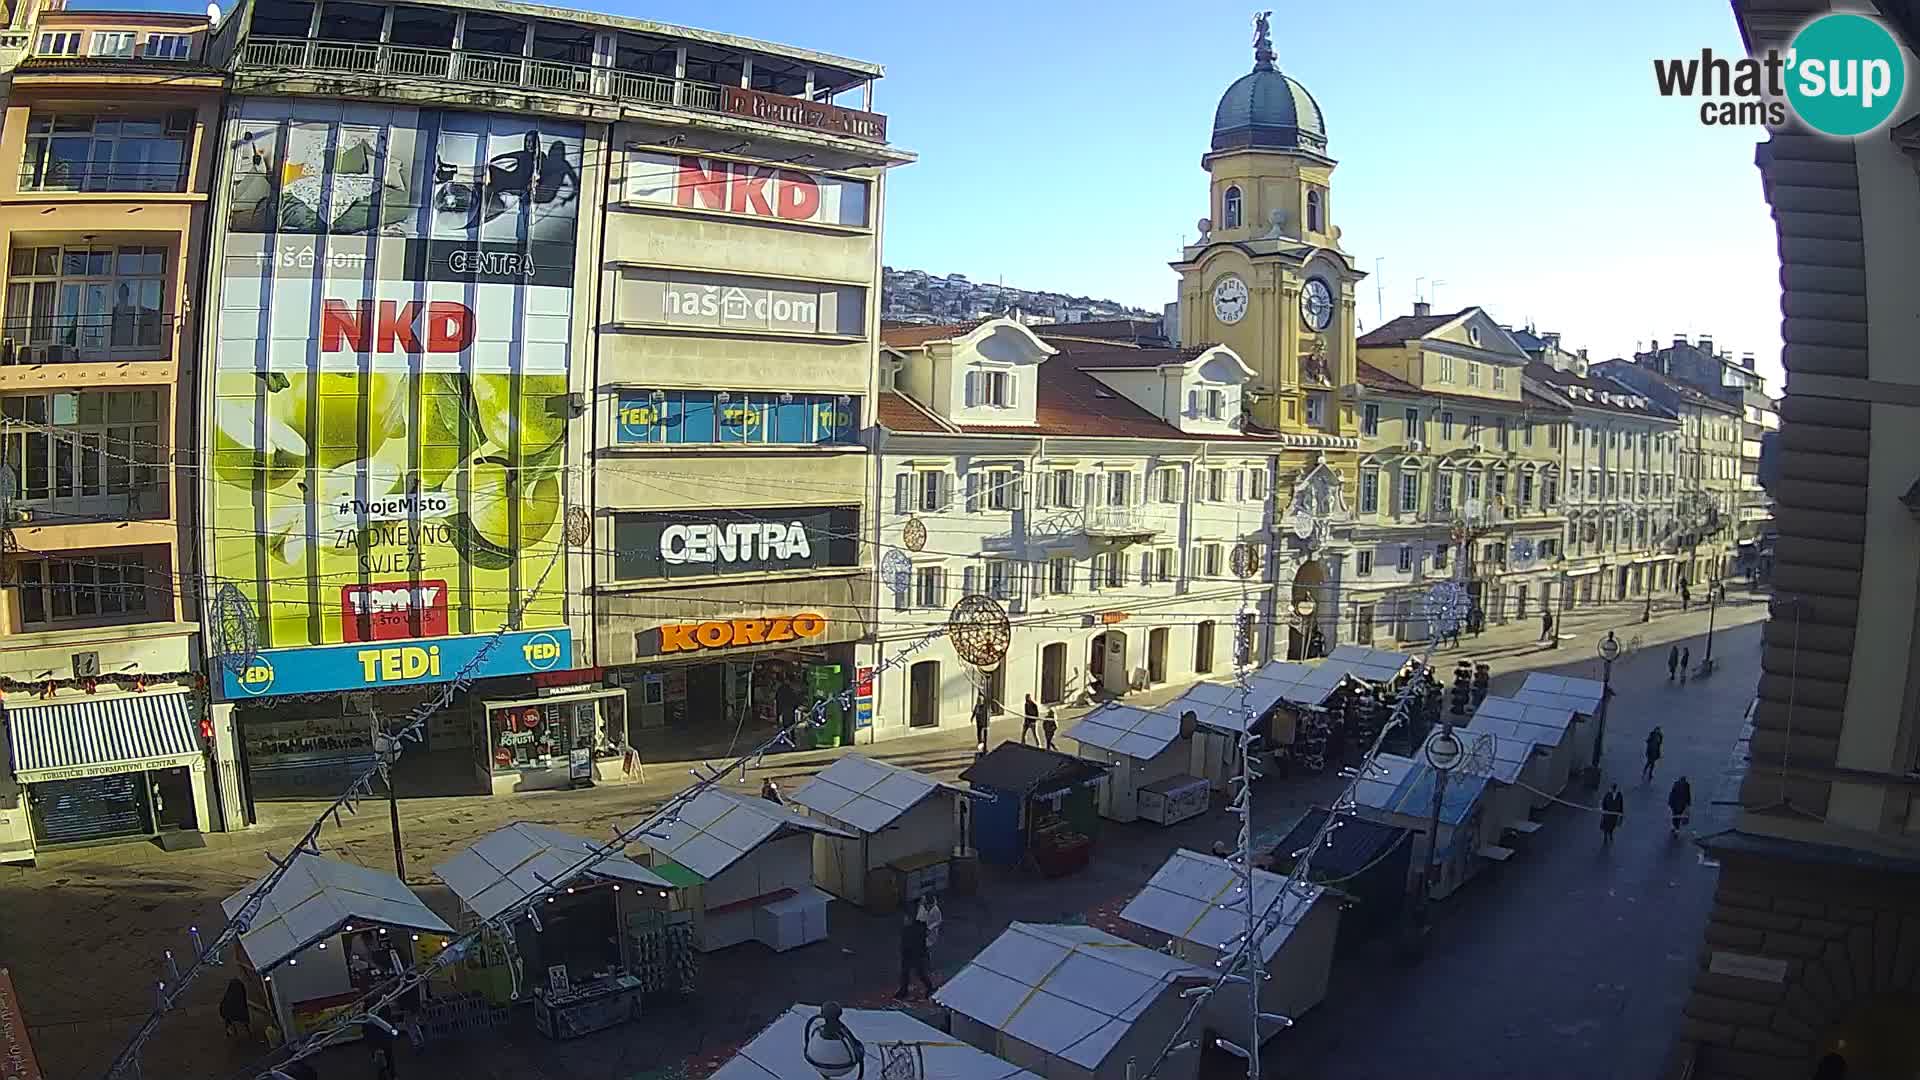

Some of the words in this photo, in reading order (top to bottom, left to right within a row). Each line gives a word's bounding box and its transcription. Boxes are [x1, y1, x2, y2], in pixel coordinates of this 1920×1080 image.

[677, 155, 821, 222] NKD
[448, 250, 536, 276] CENTRA
[664, 285, 718, 317] naš
[754, 294, 817, 323] dom
[320, 299, 477, 354] NKD
[334, 529, 360, 548] ZA
[369, 524, 450, 547] DNEVNO
[660, 521, 811, 564] CENTRA
[360, 547, 426, 575] SVJEŽE
[523, 643, 560, 660] TEDi
[661, 613, 826, 653] KORZO
[358, 646, 441, 683] TEDi
